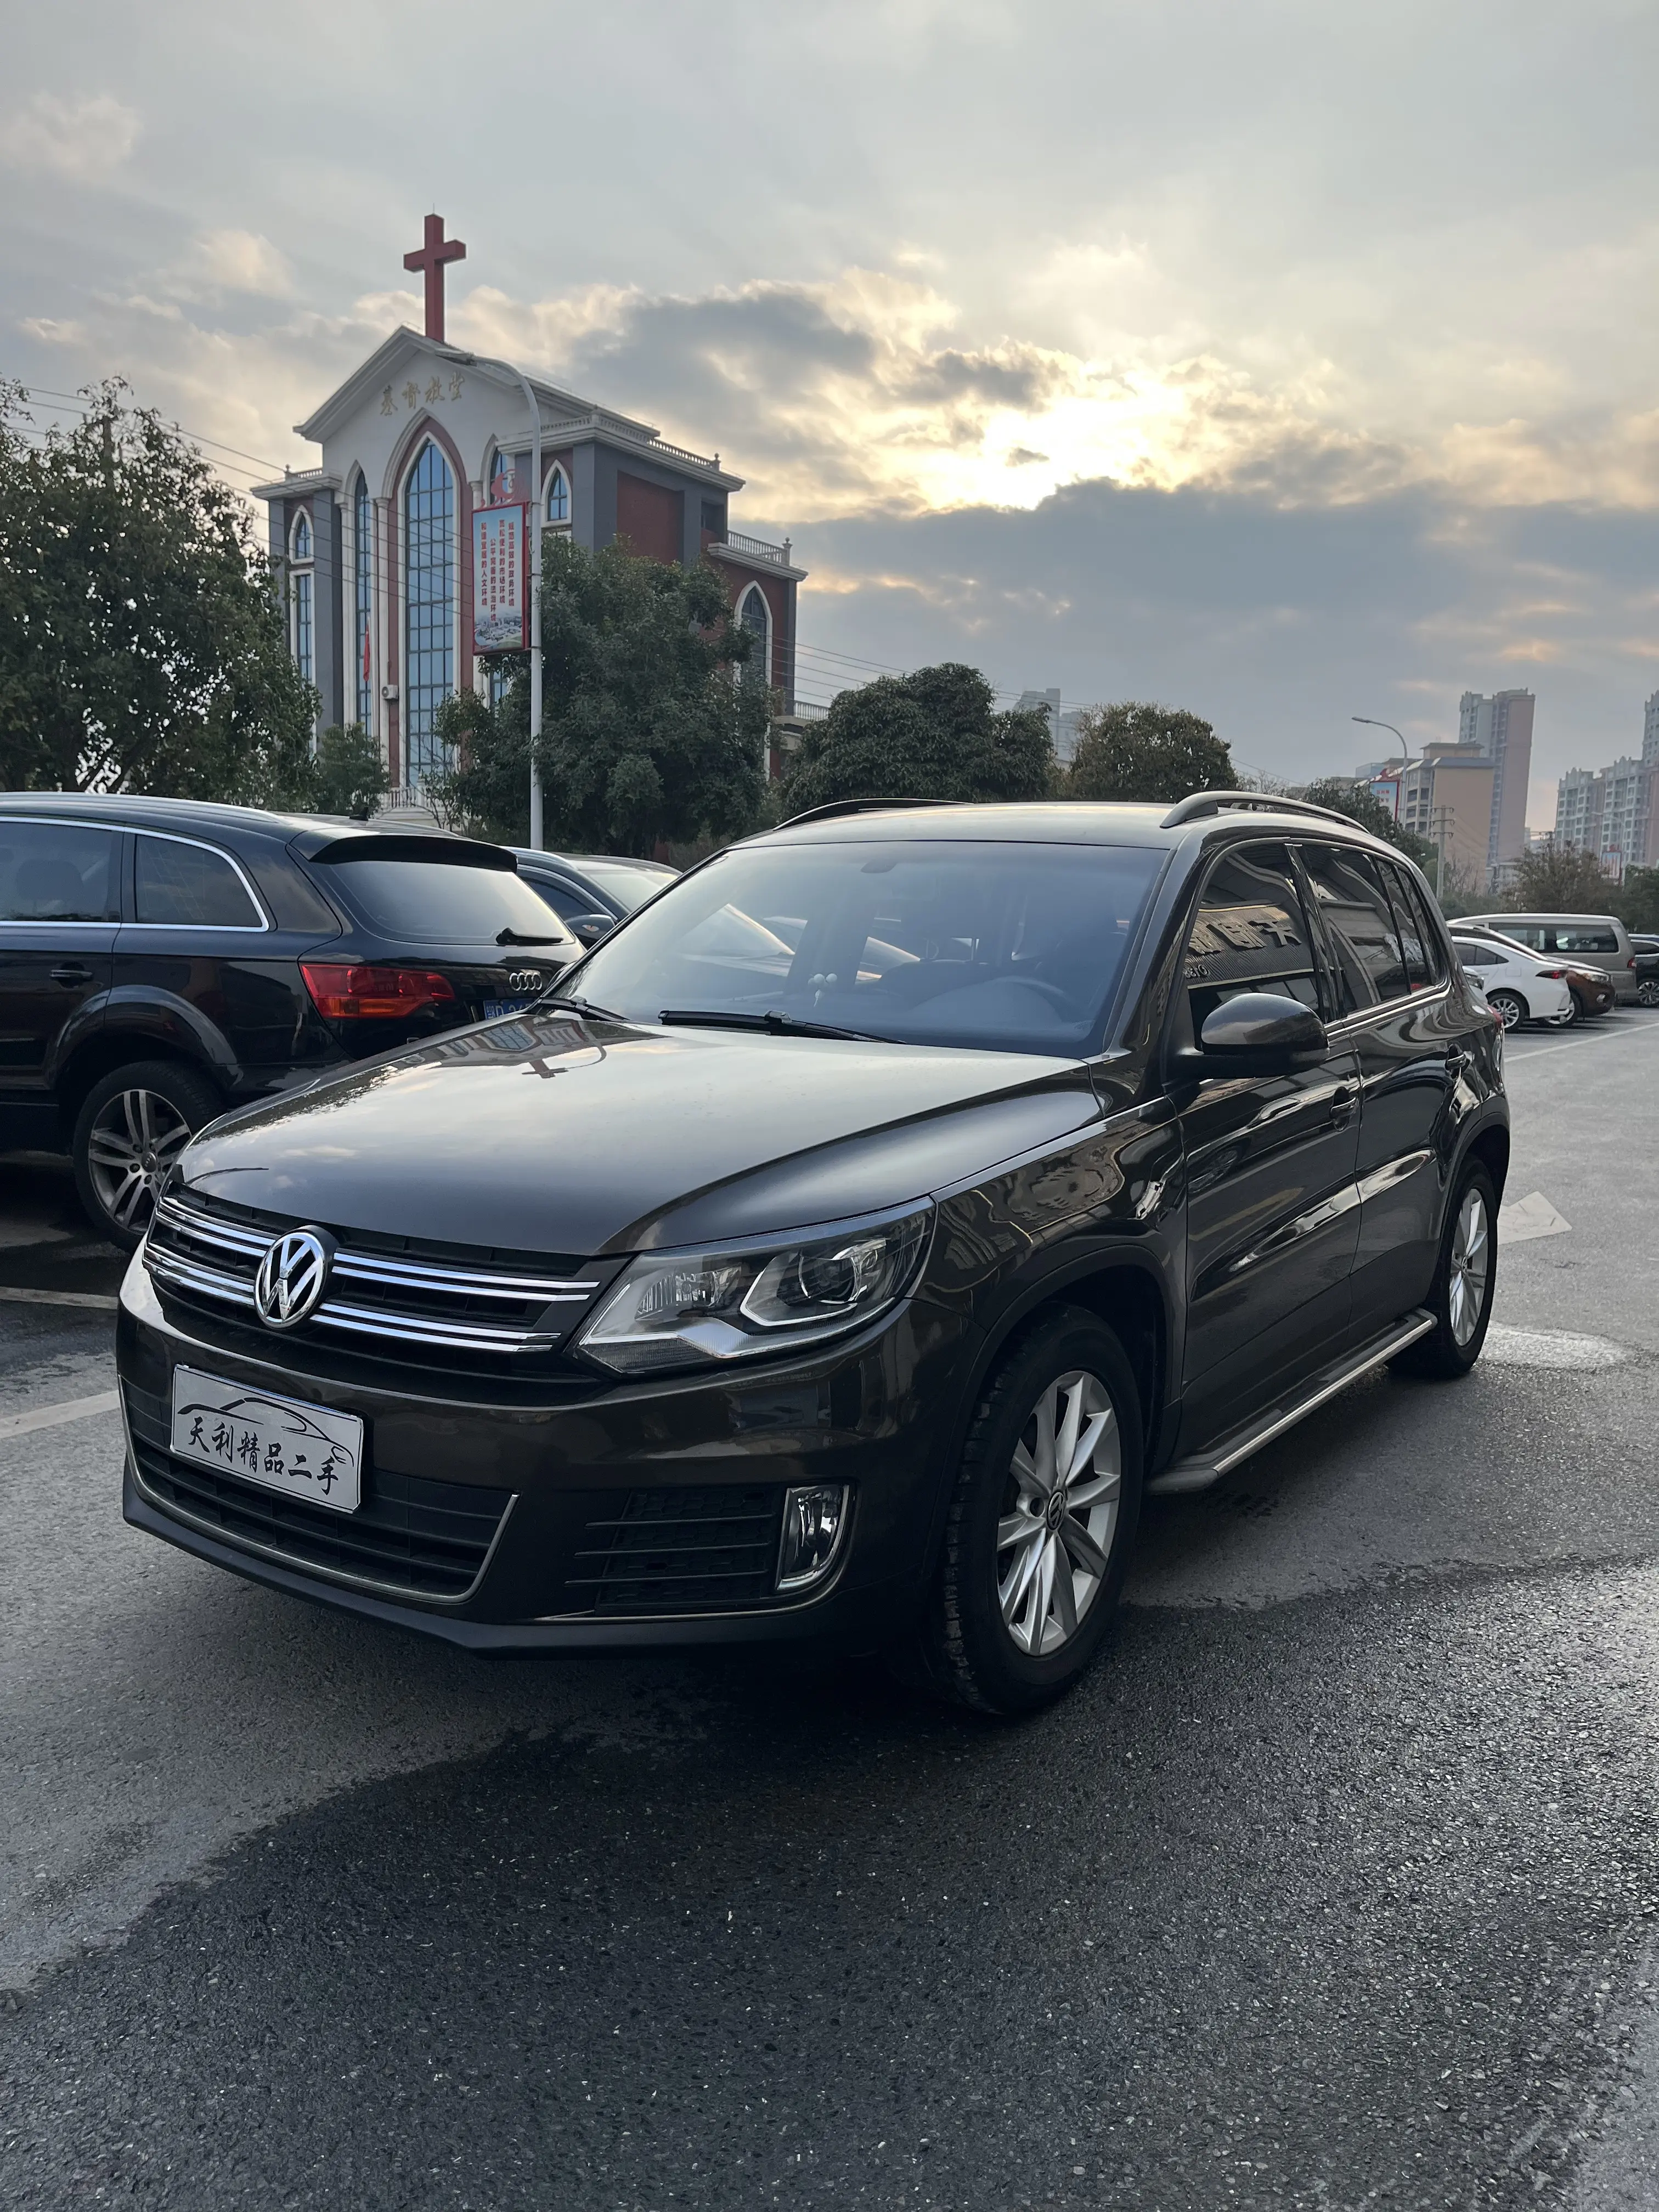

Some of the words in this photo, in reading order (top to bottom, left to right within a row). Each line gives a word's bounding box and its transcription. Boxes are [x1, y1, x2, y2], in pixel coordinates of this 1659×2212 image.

[188, 1417, 338, 1495] 天利精品二手
